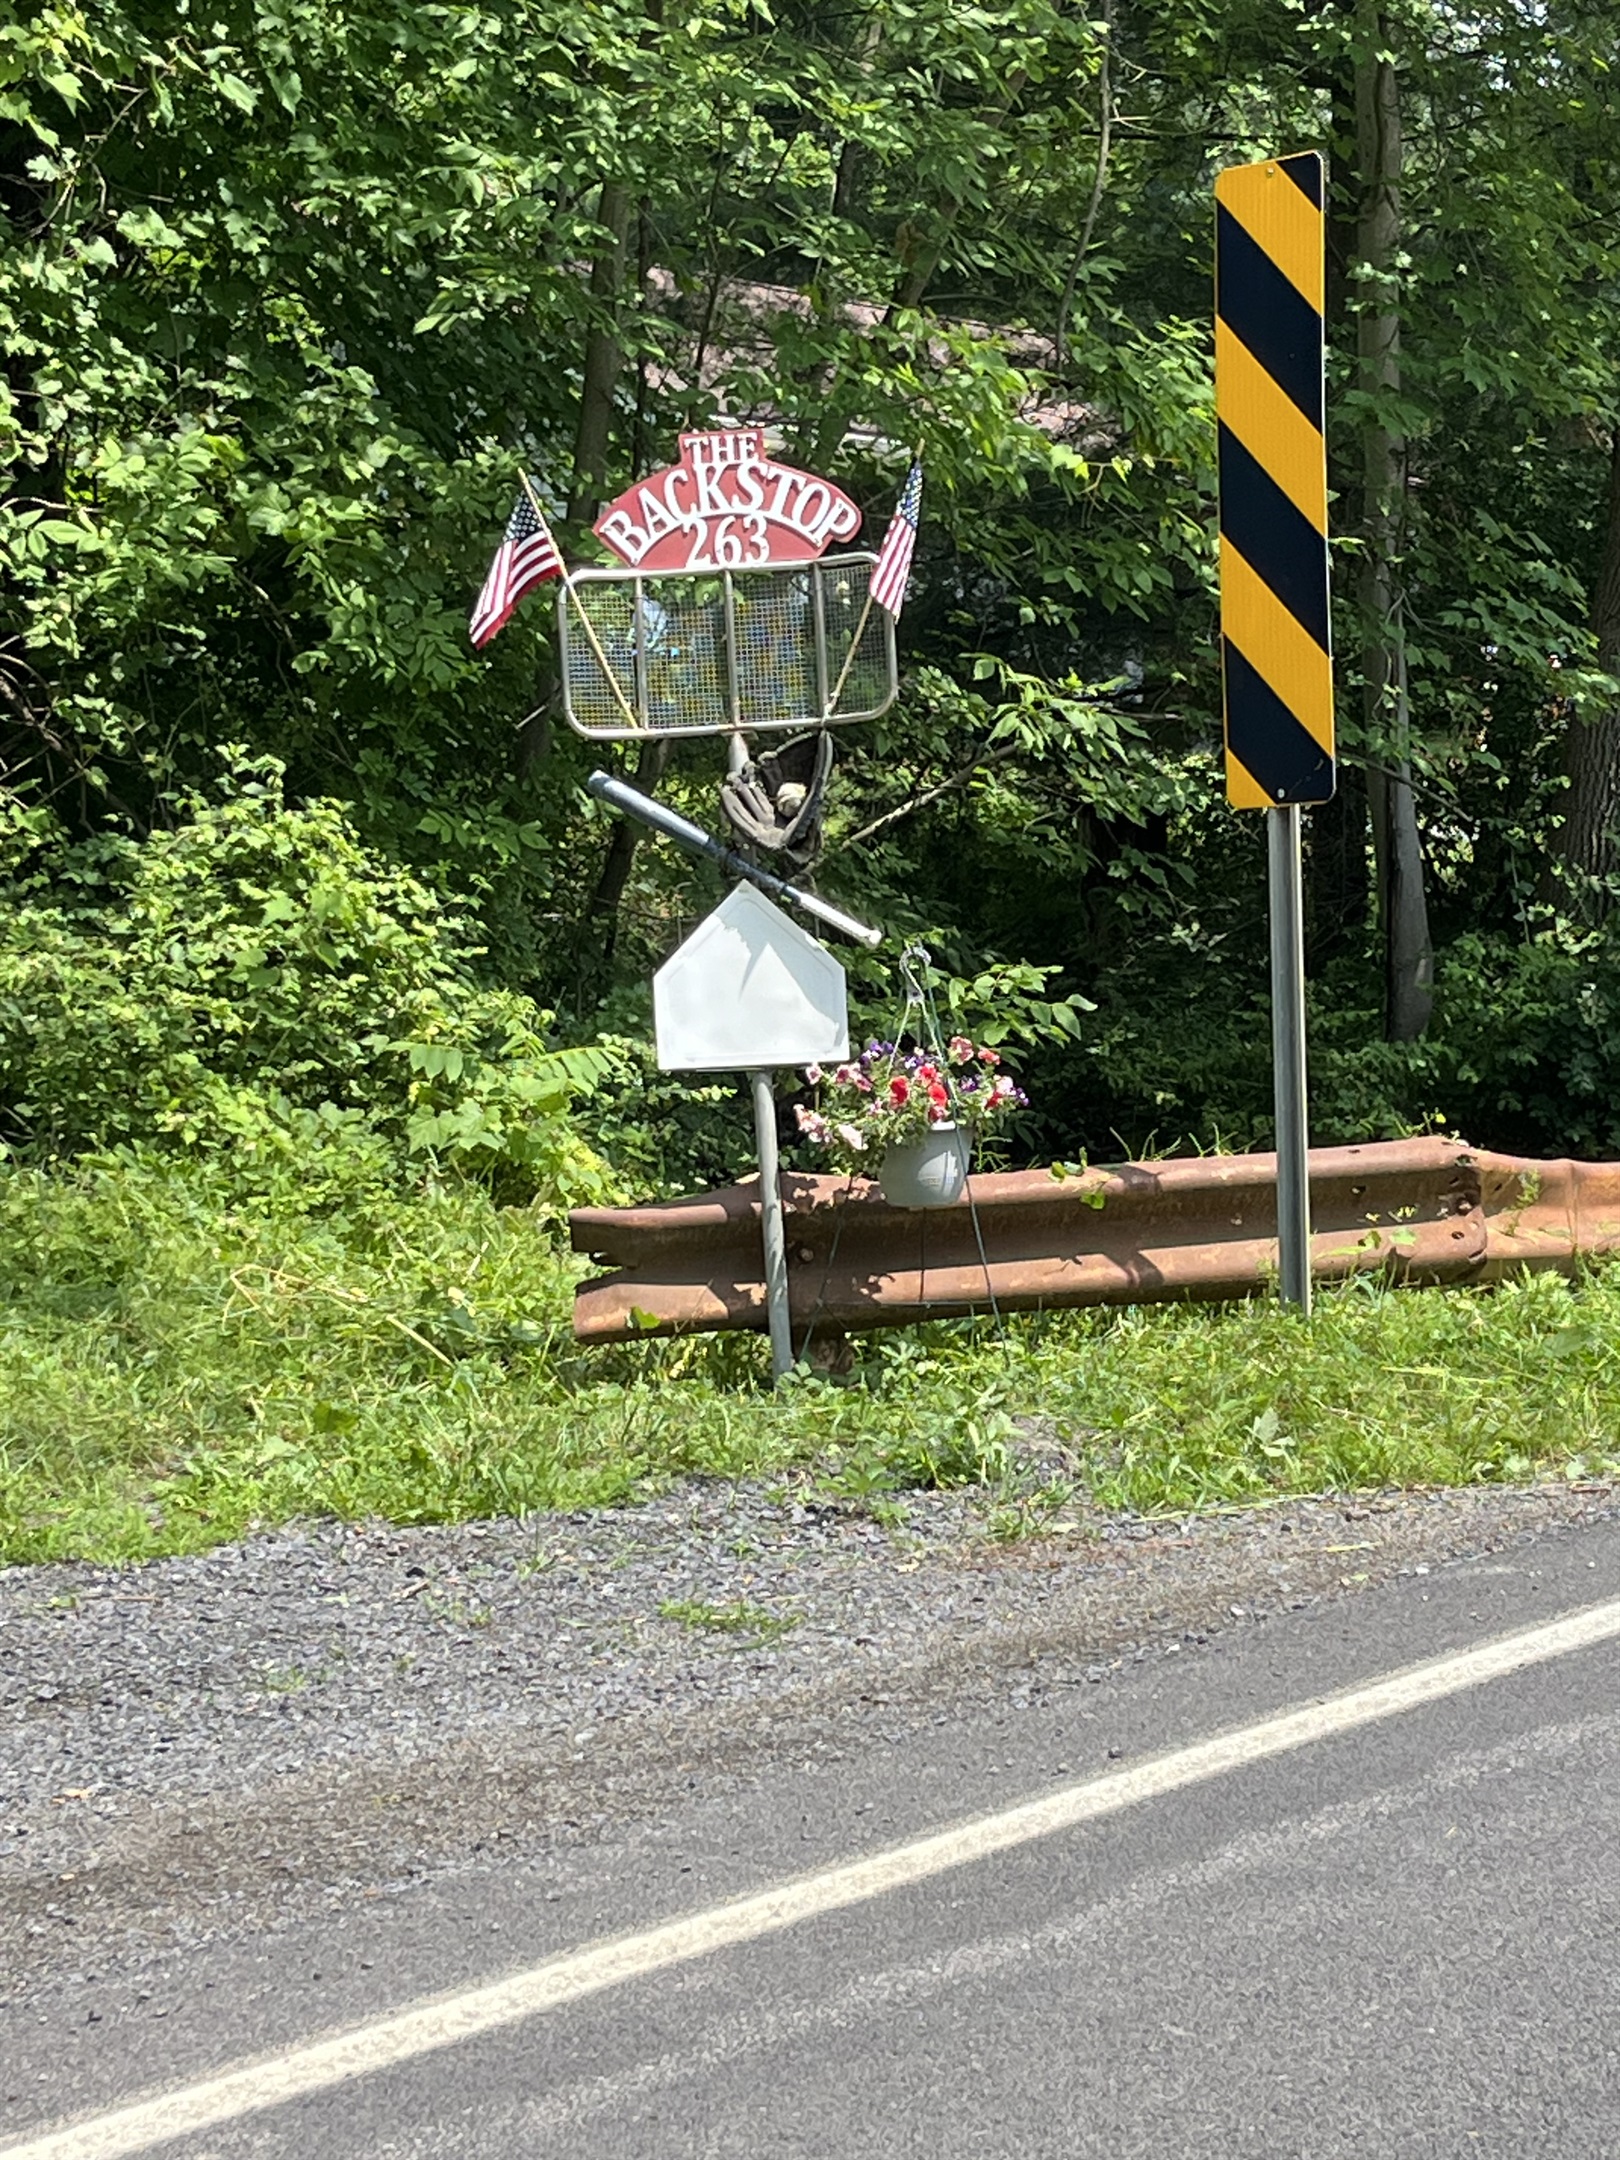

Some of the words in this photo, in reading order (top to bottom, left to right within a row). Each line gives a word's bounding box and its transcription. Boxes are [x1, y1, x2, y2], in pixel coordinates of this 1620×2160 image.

[684, 432, 759, 467] THE
[599, 462, 857, 567] BACKSTOP
[681, 514, 771, 569] 263
